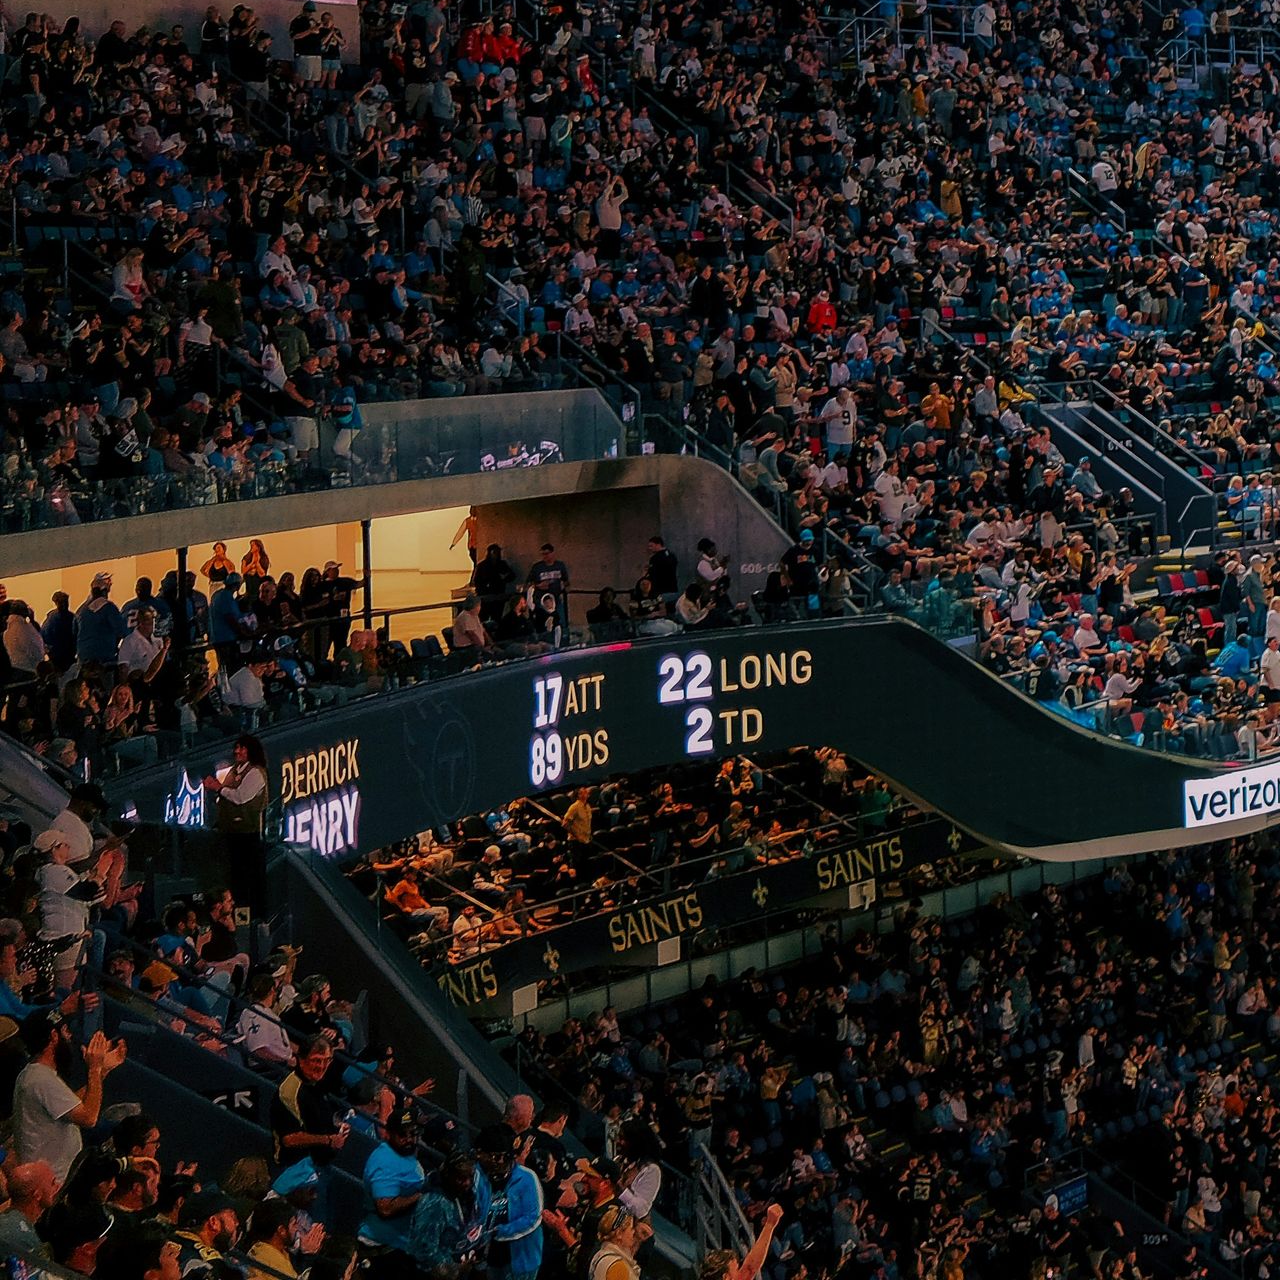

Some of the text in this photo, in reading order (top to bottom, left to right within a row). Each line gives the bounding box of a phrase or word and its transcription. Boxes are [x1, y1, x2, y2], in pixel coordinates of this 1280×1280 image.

[533, 674, 605, 728] 17 ATT
[659, 650, 812, 704] 22 LONG
[531, 729, 609, 787] 89 YDS
[687, 707, 764, 754] 2 TD
[281, 739, 360, 804] DERRICK
[816, 836, 904, 891] SAINTS
[608, 891, 703, 953] SAINTS
